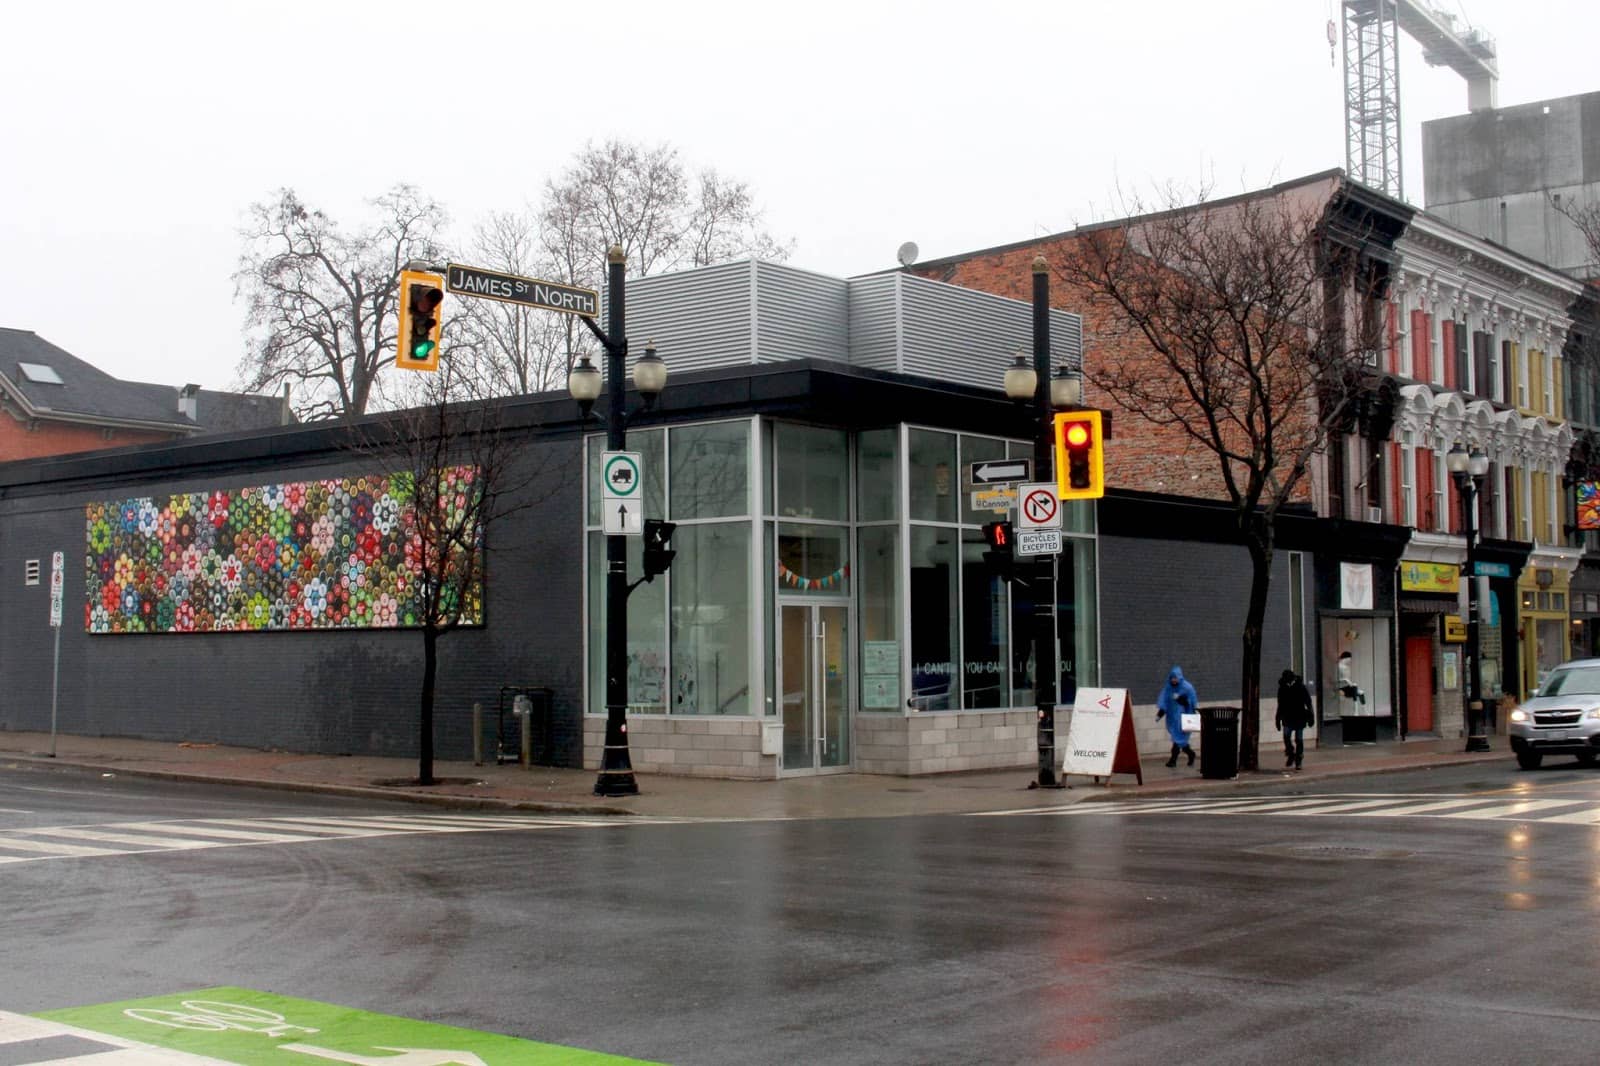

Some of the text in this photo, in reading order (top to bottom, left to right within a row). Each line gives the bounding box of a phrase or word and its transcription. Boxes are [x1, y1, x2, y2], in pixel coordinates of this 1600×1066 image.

[452, 271, 512, 297] JAMES
[535, 284, 594, 312] NORTH
[1023, 534, 1056, 543] BICYCLES
[1022, 542, 1058, 551] EXCEPTED
[965, 662, 983, 674] YOU
[1073, 749, 1108, 758] WELCOME
